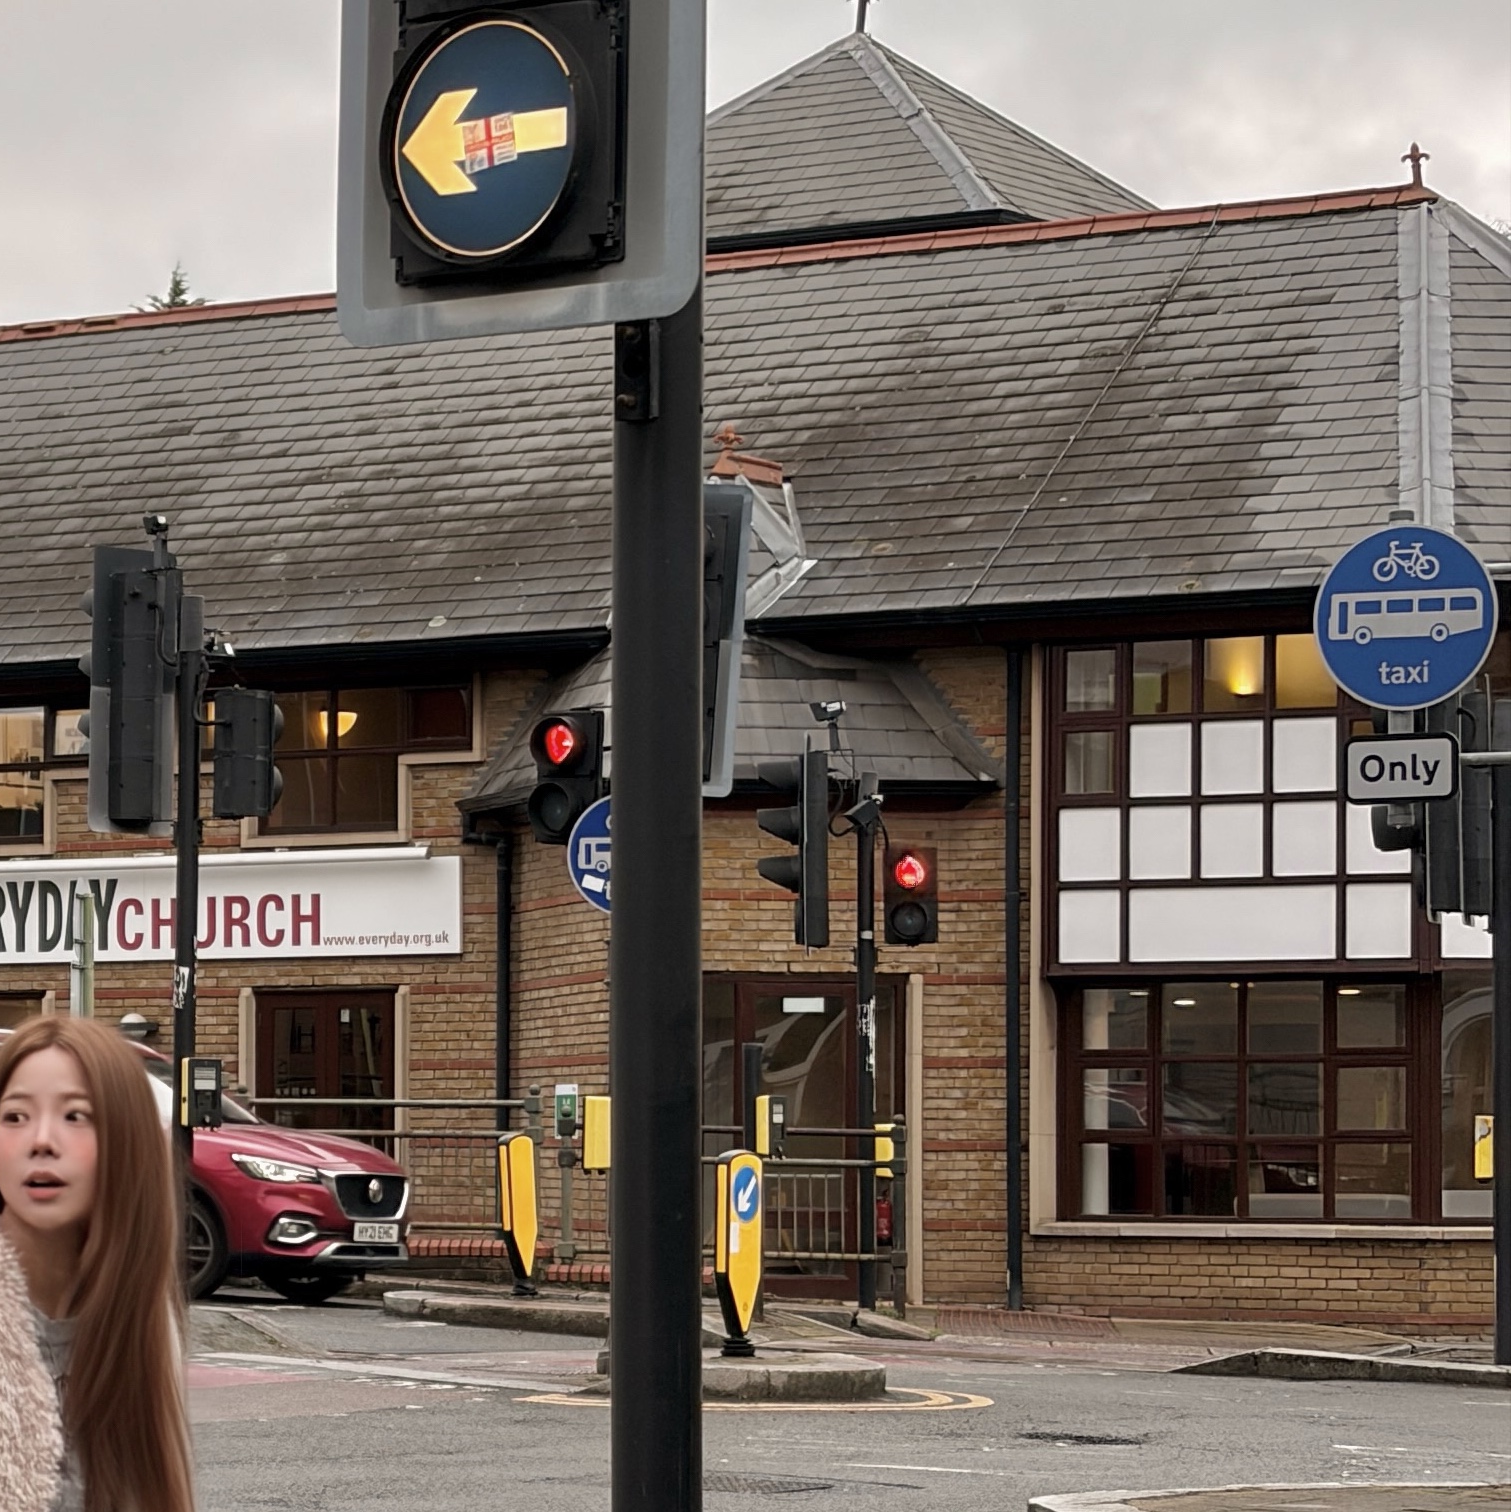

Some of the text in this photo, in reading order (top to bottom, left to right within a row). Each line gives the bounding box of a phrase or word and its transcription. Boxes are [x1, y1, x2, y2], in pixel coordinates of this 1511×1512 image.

[1378, 660, 1429, 685] taxi
[1360, 753, 1440, 786] Only
[322, 930, 450, 948] www.everyday.org.uk
